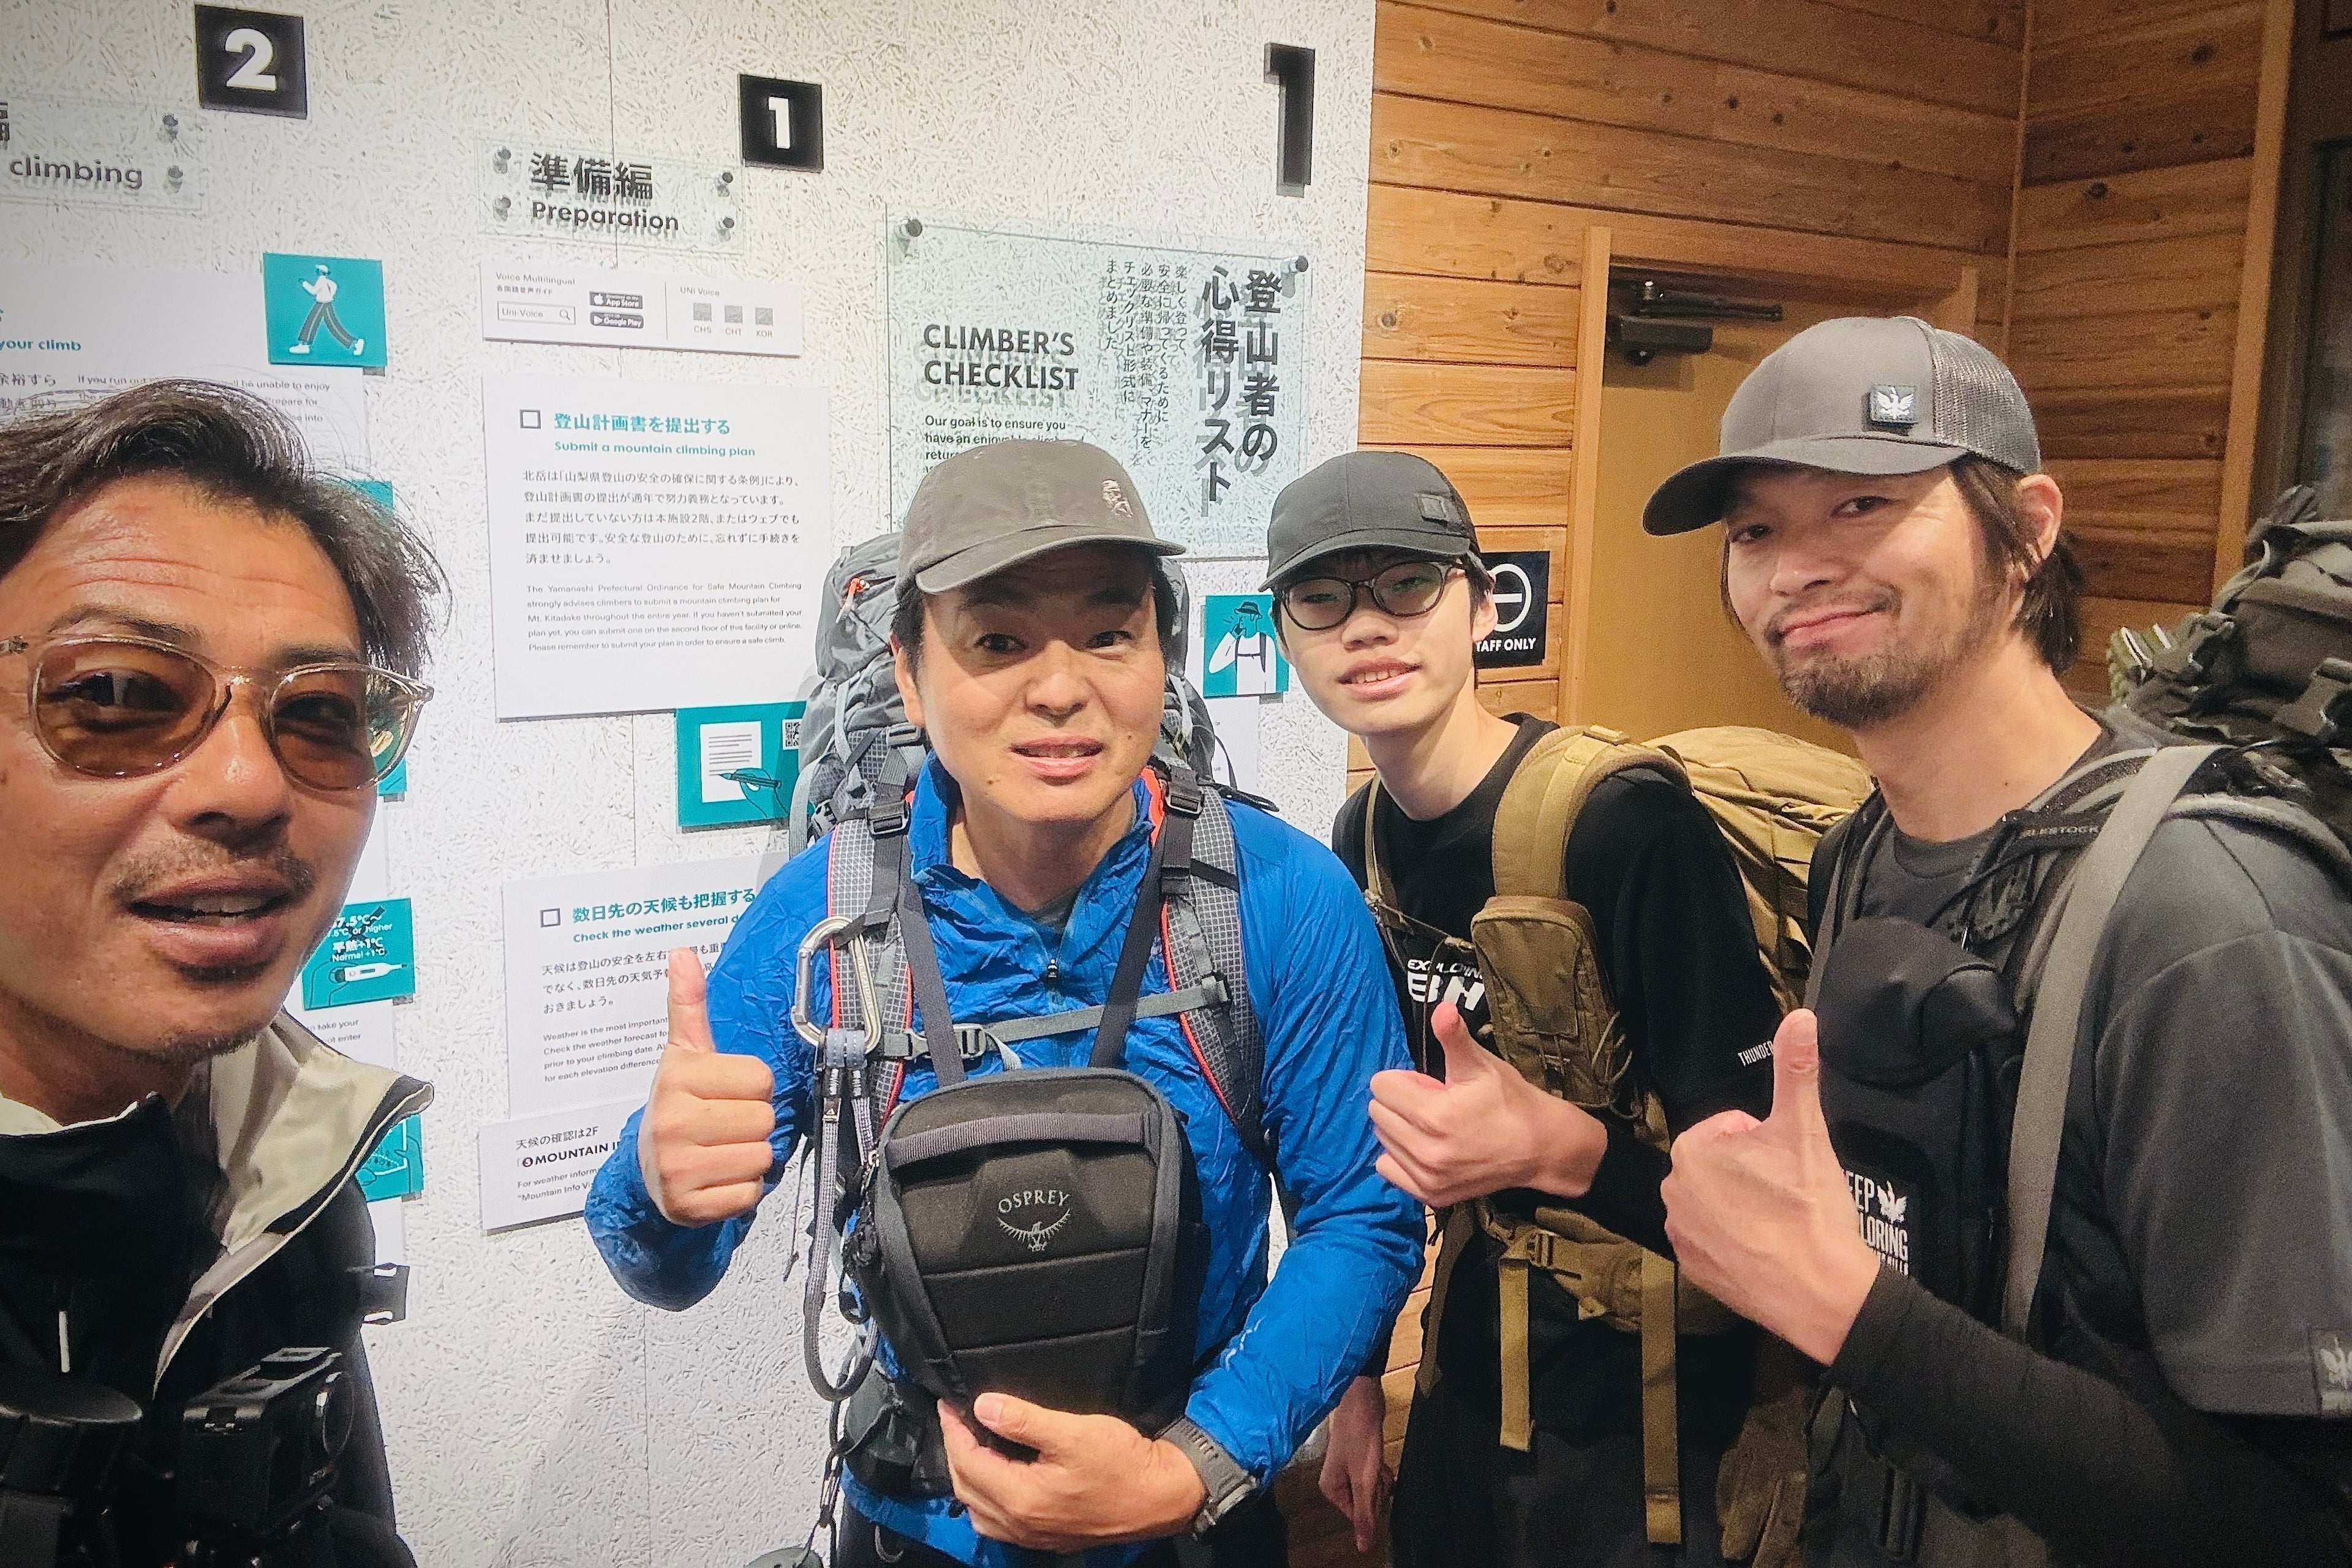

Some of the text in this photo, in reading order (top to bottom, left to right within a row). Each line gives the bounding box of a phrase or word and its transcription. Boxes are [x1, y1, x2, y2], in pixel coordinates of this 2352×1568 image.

[224, 28, 277, 91] 2
[769, 96, 790, 149] 1
[1264, 43, 1315, 197] 1
[10, 154, 142, 189] climbing
[531, 151, 654, 200] 準備編
[532, 201, 679, 231] Preparation
[496, 272, 575, 285] Voice Multilingual
[680, 286, 720, 296] UNI Voice
[0, 338, 81, 351] your climb
[1243, 269, 1281, 461] 登山者の
[924, 360, 1079, 390] CHECKLIST
[1202, 265, 1239, 501] 心得リスト
[257, 380, 290, 390] unable
[293, 382, 302, 390] to
[304, 383, 330, 392] enjoy
[554, 413, 730, 435] 登山計画書を提出する
[925, 415, 1066, 431] Our goal is to ensure you
[925, 432, 955, 443] have
[956, 434, 970, 443] an
[554, 441, 756, 458] Submit a mountain climbing plan
[548, 584, 594, 593] Yamanashi
[647, 583, 688, 592] Ordinance
[769, 582, 802, 590] Climbing
[527, 600, 561, 609] strongly
[564, 598, 595, 607] advises
[597, 598, 631, 606] climbers
[718, 597, 751, 605] climbing
[753, 596, 769, 605] plan
[584, 613, 629, 622] throughout
[528, 629, 546, 638] plan
[671, 625, 699, 633] second
[745, 624, 767, 632] facility
[529, 643, 556, 652] Please
[558, 643, 600, 651] remember
[639, 641, 656, 650] your
[1476, 637, 1536, 652] TAFF ONLY
[573, 888, 756, 923] 数日先の天候も把握する
[365, 924, 392, 933] higher
[573, 931, 609, 943] Check
[612, 927, 631, 938] the
[635, 923, 683, 936] weather
[687, 915, 729, 929] several
[332, 951, 363, 962] Normal
[543, 996, 614, 1014] おきましょう。
[339, 1020, 359, 1030] your
[543, 1031, 579, 1042] Weather
[628, 1017, 668, 1028] important
[544, 1045, 571, 1055] Check
[588, 1038, 622, 1049] weather
[624, 1033, 657, 1043] forecast
[544, 1061, 564, 1070] prior
[576, 1056, 595, 1066] your
[597, 1049, 633, 1061] climbing
[558, 1071, 579, 1081] each
[581, 1065, 619, 1077] elevation
[516, 1126, 598, 1151] 天候の確認は2F
[518, 1167, 597, 1189] For weather inform
[564, 1184, 581, 1193] Info
[998, 1189, 1071, 1213] OSPREY
[1860, 1213, 1909, 1262] LORING
